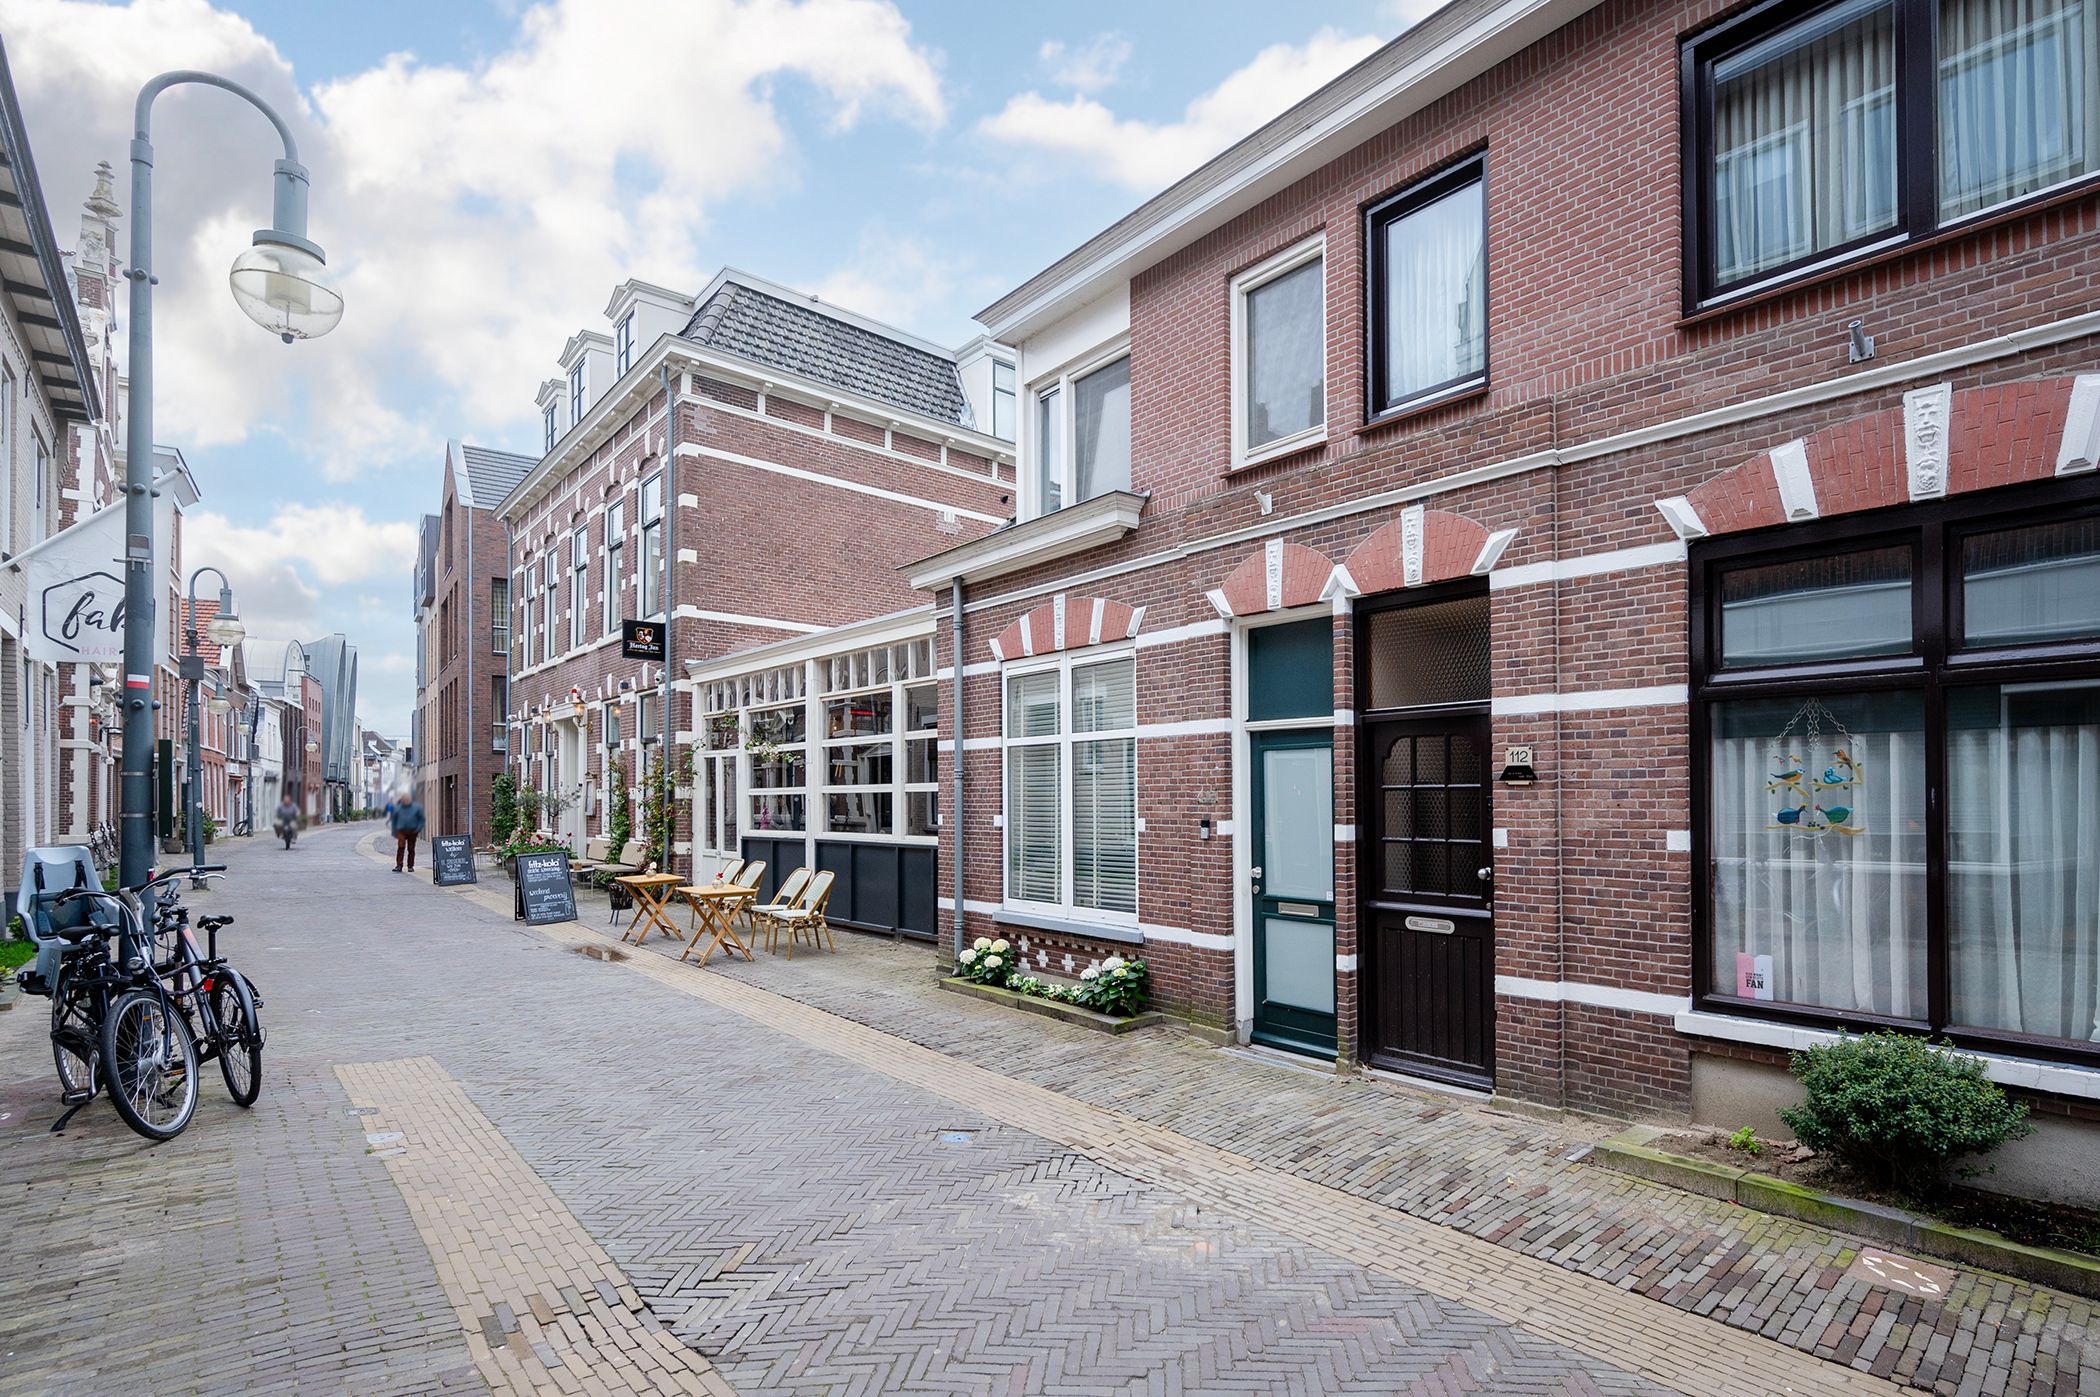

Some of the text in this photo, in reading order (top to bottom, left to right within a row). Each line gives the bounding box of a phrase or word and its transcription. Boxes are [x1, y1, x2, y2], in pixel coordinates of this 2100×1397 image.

[81, 646, 117, 656] HAIR
[1509, 750, 1529, 763] 112
[528, 858, 560, 868] fritz-kola
[1746, 979, 1763, 989] FAN
